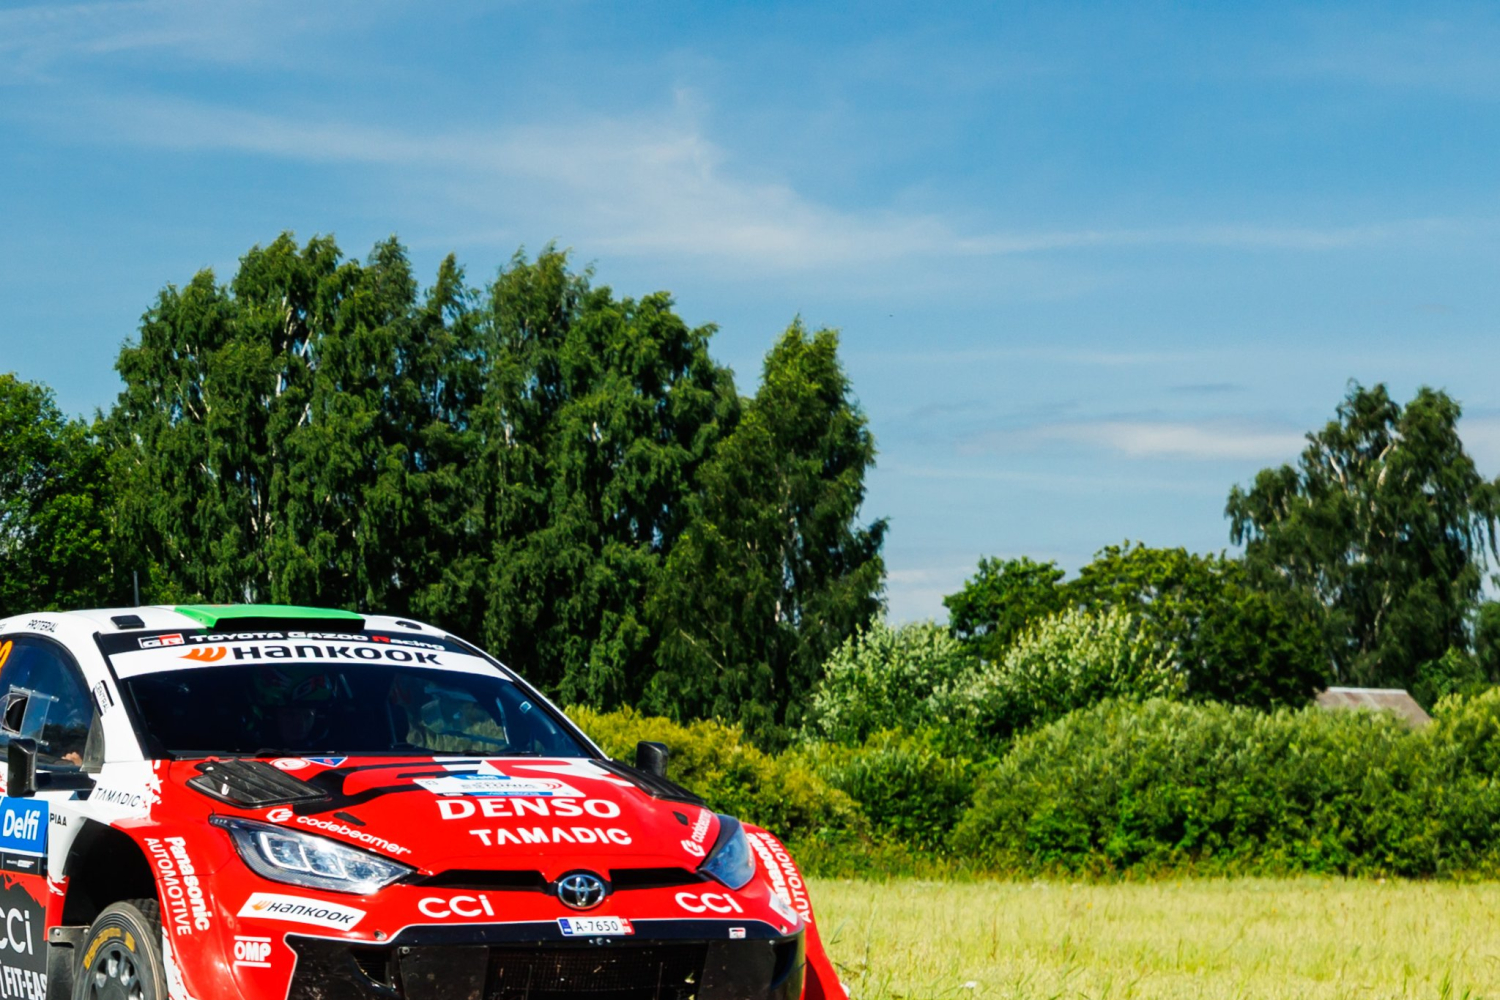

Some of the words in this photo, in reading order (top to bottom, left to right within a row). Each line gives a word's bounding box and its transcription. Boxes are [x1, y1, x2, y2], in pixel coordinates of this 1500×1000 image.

[190, 632, 283, 642] TOYOTA
[372, 635, 446, 651] Racing
[94, 788, 141, 808] TAMADIC
[435, 798, 621, 820] DENSO
[2, 809, 41, 841] Delfi
[50, 813, 67, 826] PIAA
[297, 815, 407, 856] codebeamer
[469, 827, 632, 846] TAMADIC
[746, 833, 792, 906] anasonic
[756, 832, 812, 923] AUTOMOTIVE
[144, 838, 192, 936] AUTOMOTIVE
[164, 836, 213, 931] Panasonic
[576, 921, 618, 932] A-7650
[234, 940, 271, 962] OMP
